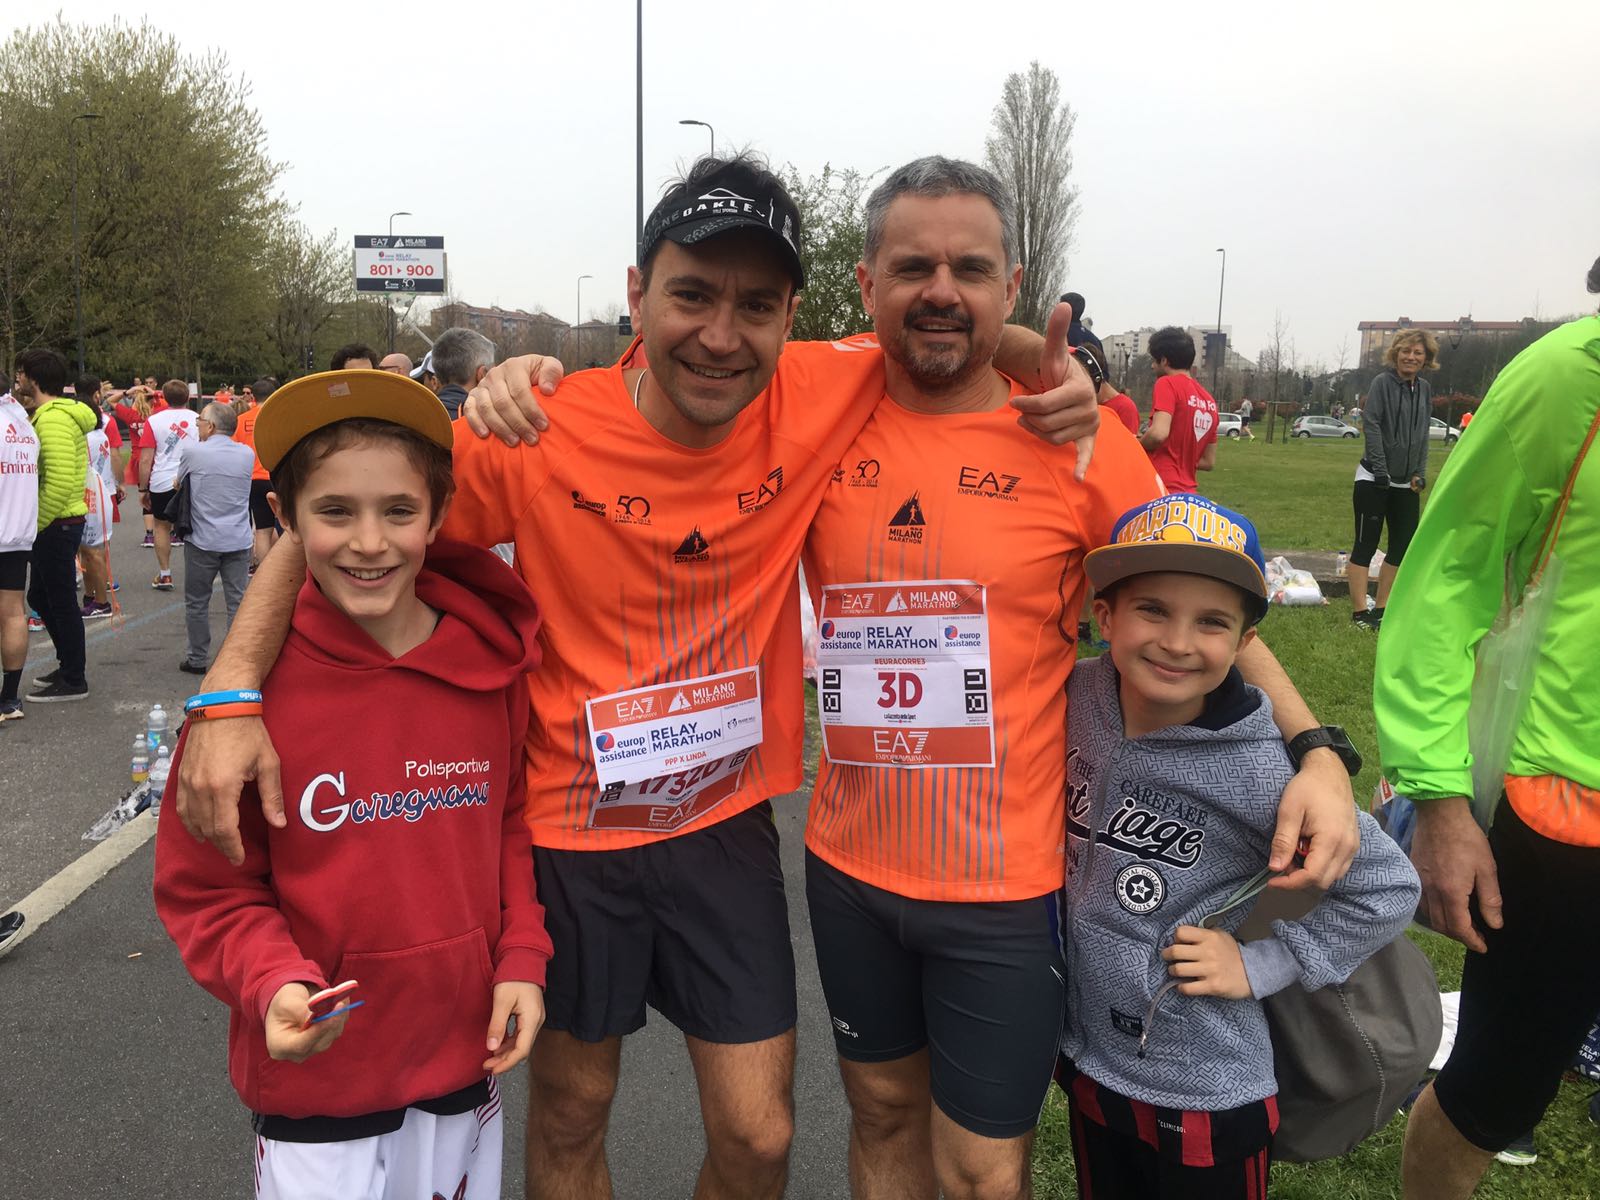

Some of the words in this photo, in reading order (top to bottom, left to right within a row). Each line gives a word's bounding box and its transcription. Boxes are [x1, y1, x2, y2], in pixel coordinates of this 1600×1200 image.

[370, 238, 389, 246] EA7
[370, 264, 393, 276] 801
[406, 264, 434, 276] 900
[5, 434, 35, 445] adidas
[16, 450, 29, 461] Fly
[737, 466, 783, 510] EA7
[957, 466, 1022, 494] EA7
[615, 495, 651, 518] 50
[1188, 496, 1217, 513] STATE
[889, 527, 923, 539] MILANO
[841, 593, 875, 609] EA7
[910, 590, 957, 602] MILANO
[910, 601, 959, 609] MARATHON
[836, 629, 862, 641] europ
[866, 626, 913, 639] RELAY
[959, 632, 981, 641] europ
[820, 639, 862, 650] assistance
[867, 638, 938, 649] MARATHON
[944, 640, 982, 648] assistance
[692, 681, 735, 699] MILANO
[876, 671, 923, 709] 3D
[693, 691, 736, 706] MARATHON
[616, 696, 655, 719] EA7
[651, 722, 698, 742] RELAY
[652, 728, 721, 752] MARATHON
[617, 735, 646, 750] europ
[873, 730, 929, 754] EA7
[599, 746, 648, 763] assistance
[665, 757, 679, 766] PPP
[685, 751, 707, 762] LINDA
[404, 757, 490, 780] Polisportiva
[649, 794, 699, 823] EA7
[1119, 868, 1140, 886] ROYAL
[1141, 869, 1160, 898] COLLEGE
[1120, 893, 1151, 911] STUDENT
